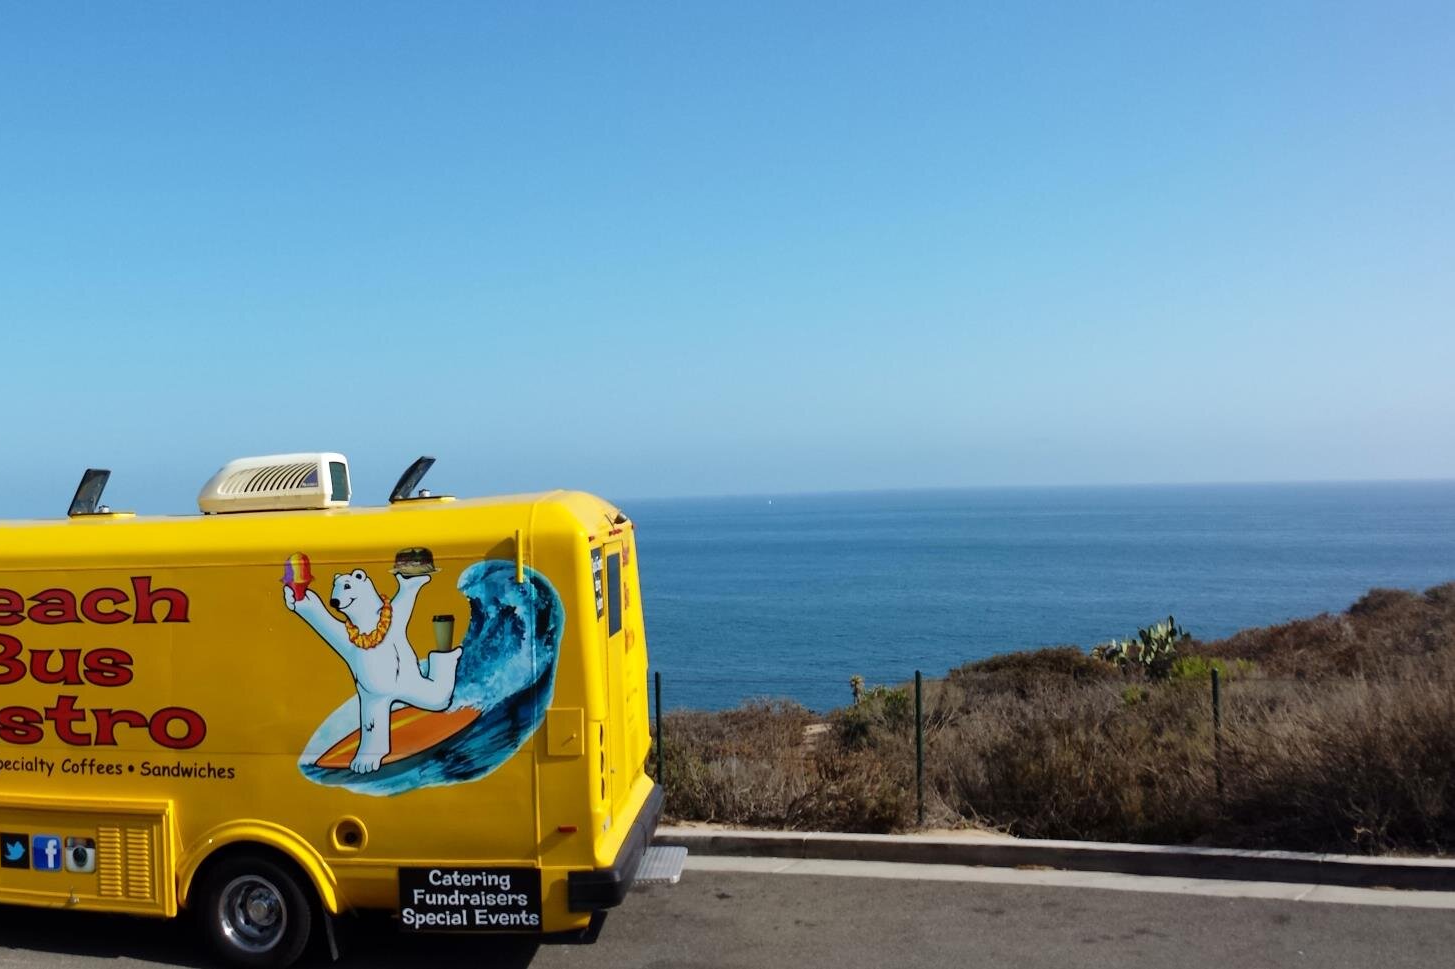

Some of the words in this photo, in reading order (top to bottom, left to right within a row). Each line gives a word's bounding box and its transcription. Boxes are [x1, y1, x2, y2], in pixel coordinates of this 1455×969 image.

[61, 758, 123, 776] Coffees
[140, 760, 236, 779] Sandwiches
[428, 869, 511, 891] Catering
[413, 889, 528, 907] Fundraisers
[402, 907, 468, 929] Special
[475, 909, 540, 926] Events
